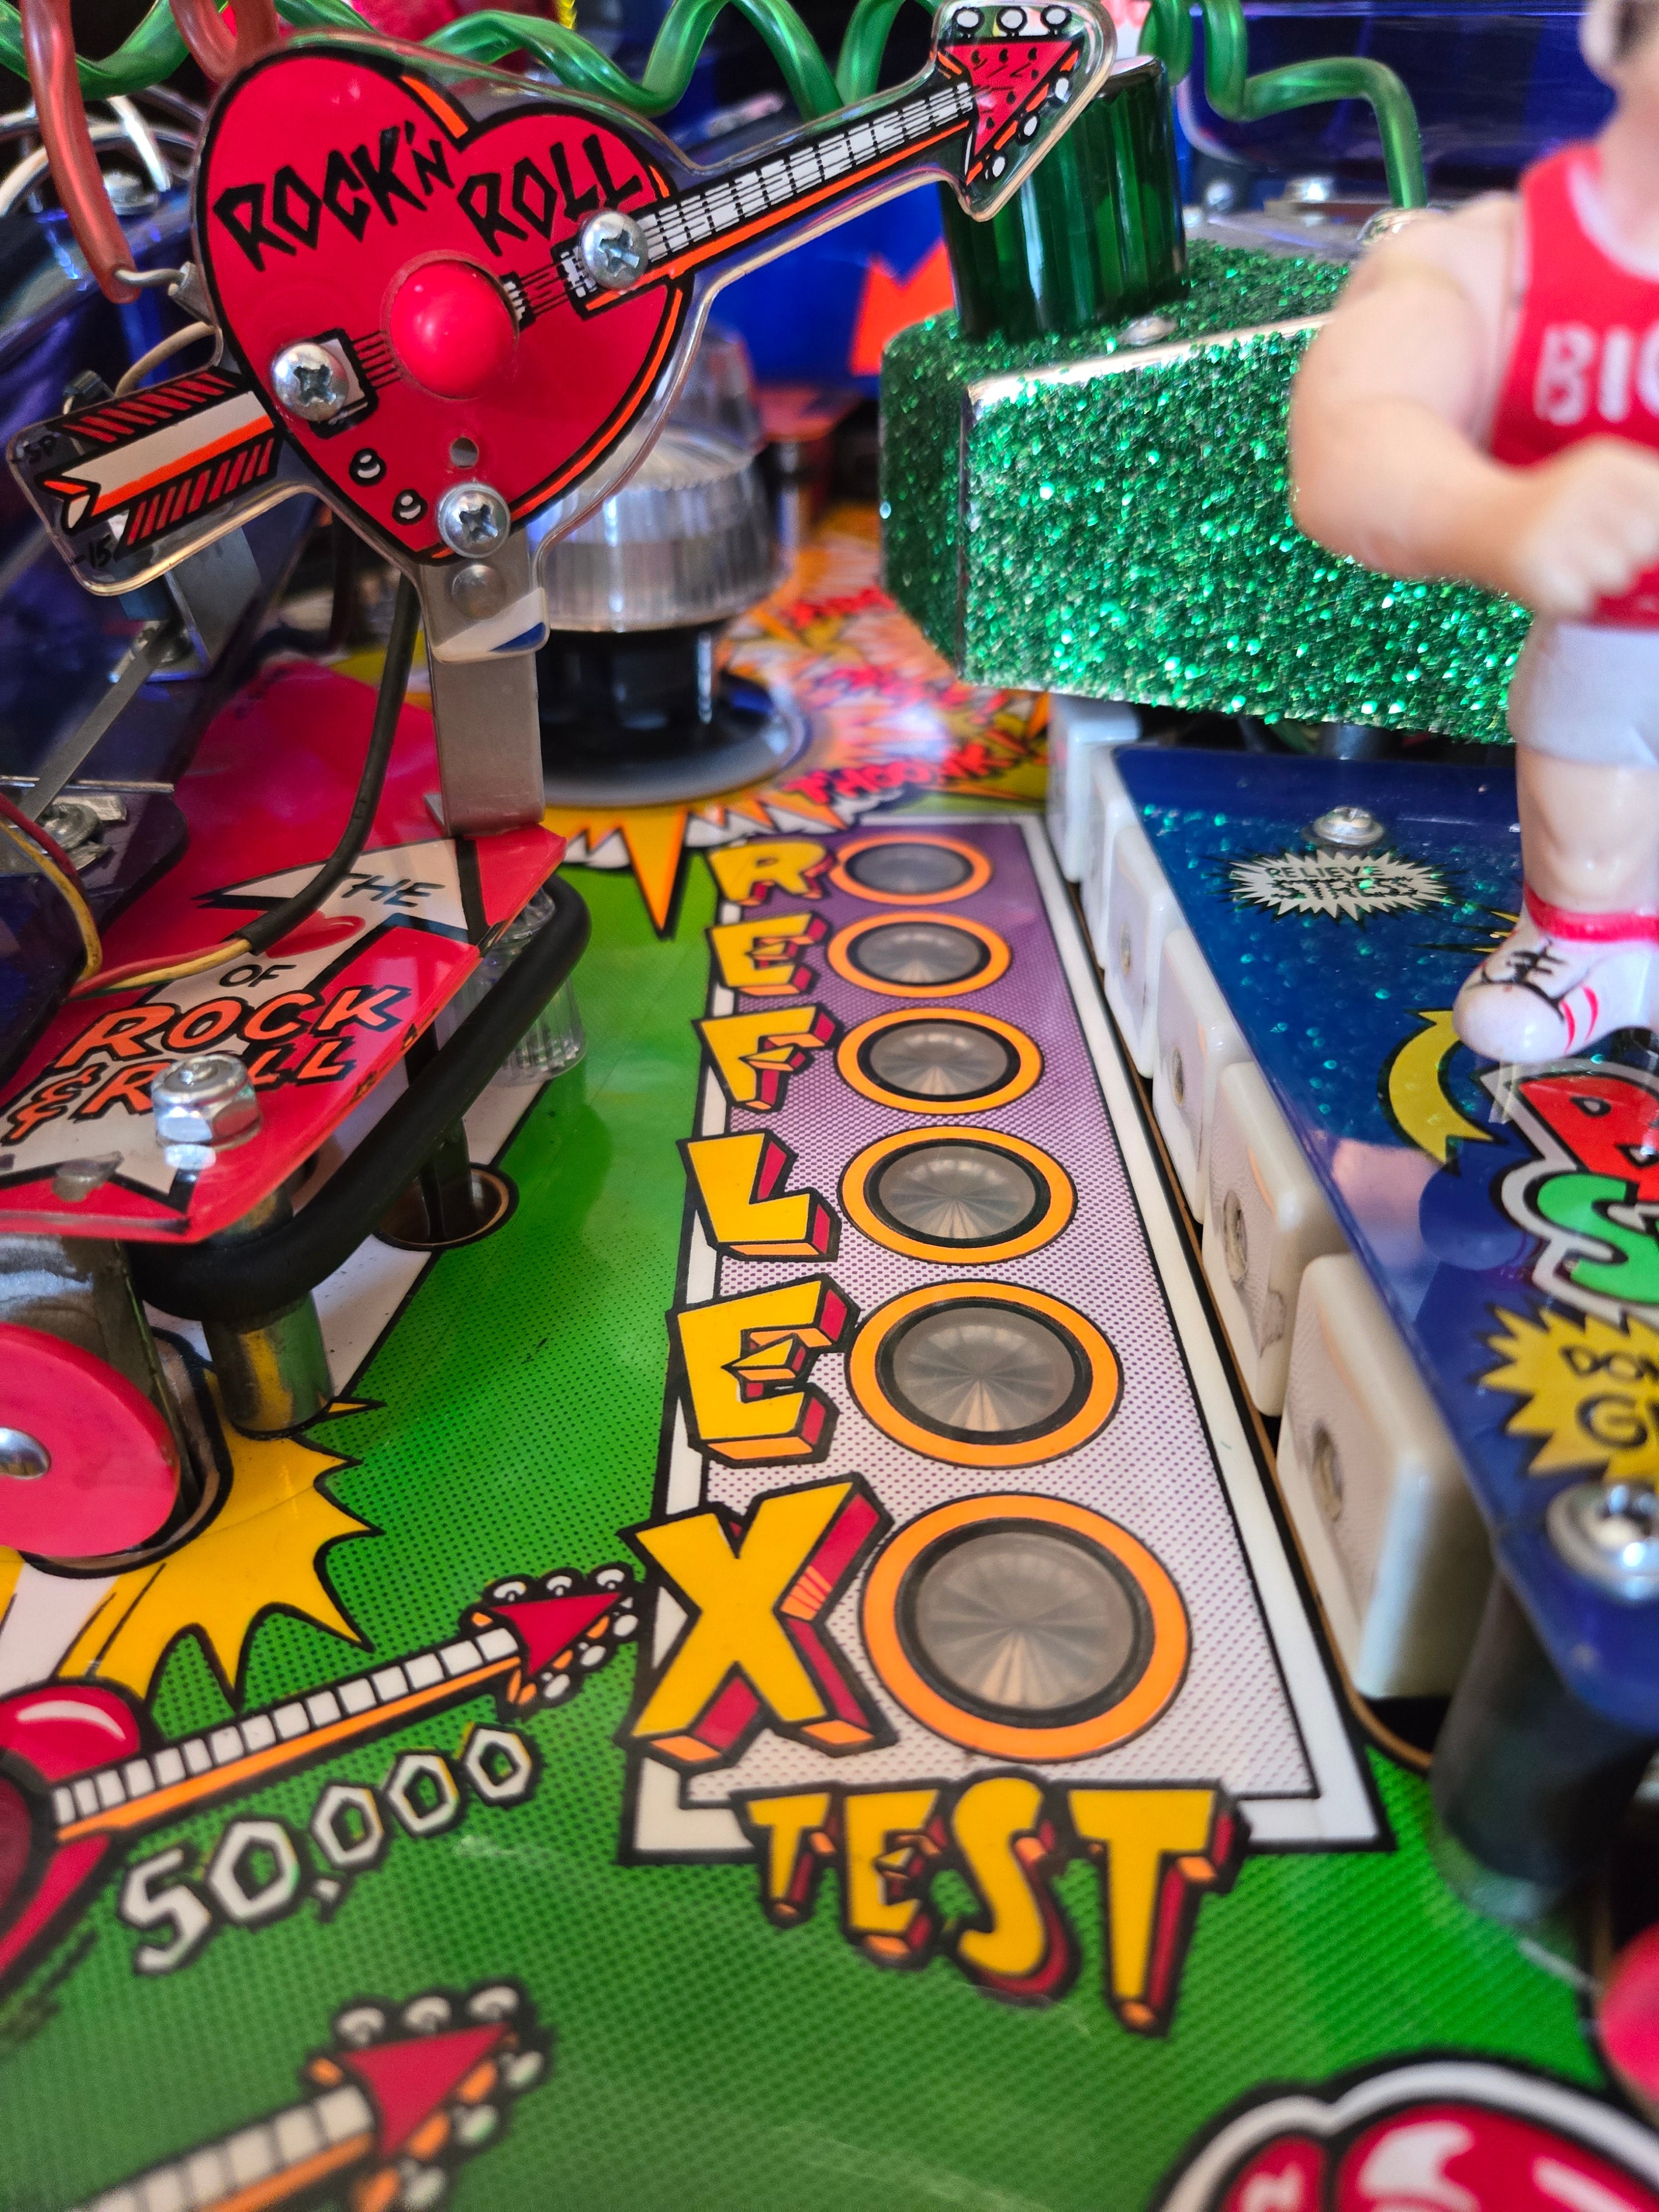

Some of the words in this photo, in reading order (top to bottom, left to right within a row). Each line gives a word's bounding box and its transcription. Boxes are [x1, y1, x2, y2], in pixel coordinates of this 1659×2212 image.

[457, 134, 643, 256] ROLL
[1264, 865, 1385, 878] RELIEVE
[1269, 877, 1418, 900] STRESS
[220, 963, 297, 988] OF
[51, 985, 412, 1070] ROCK
[71, 1037, 357, 1121] RLL
[618, 837, 896, 1765] REFLEX
[116, 1722, 542, 1975] 50,000
[738, 1772, 1247, 2035] TEST
